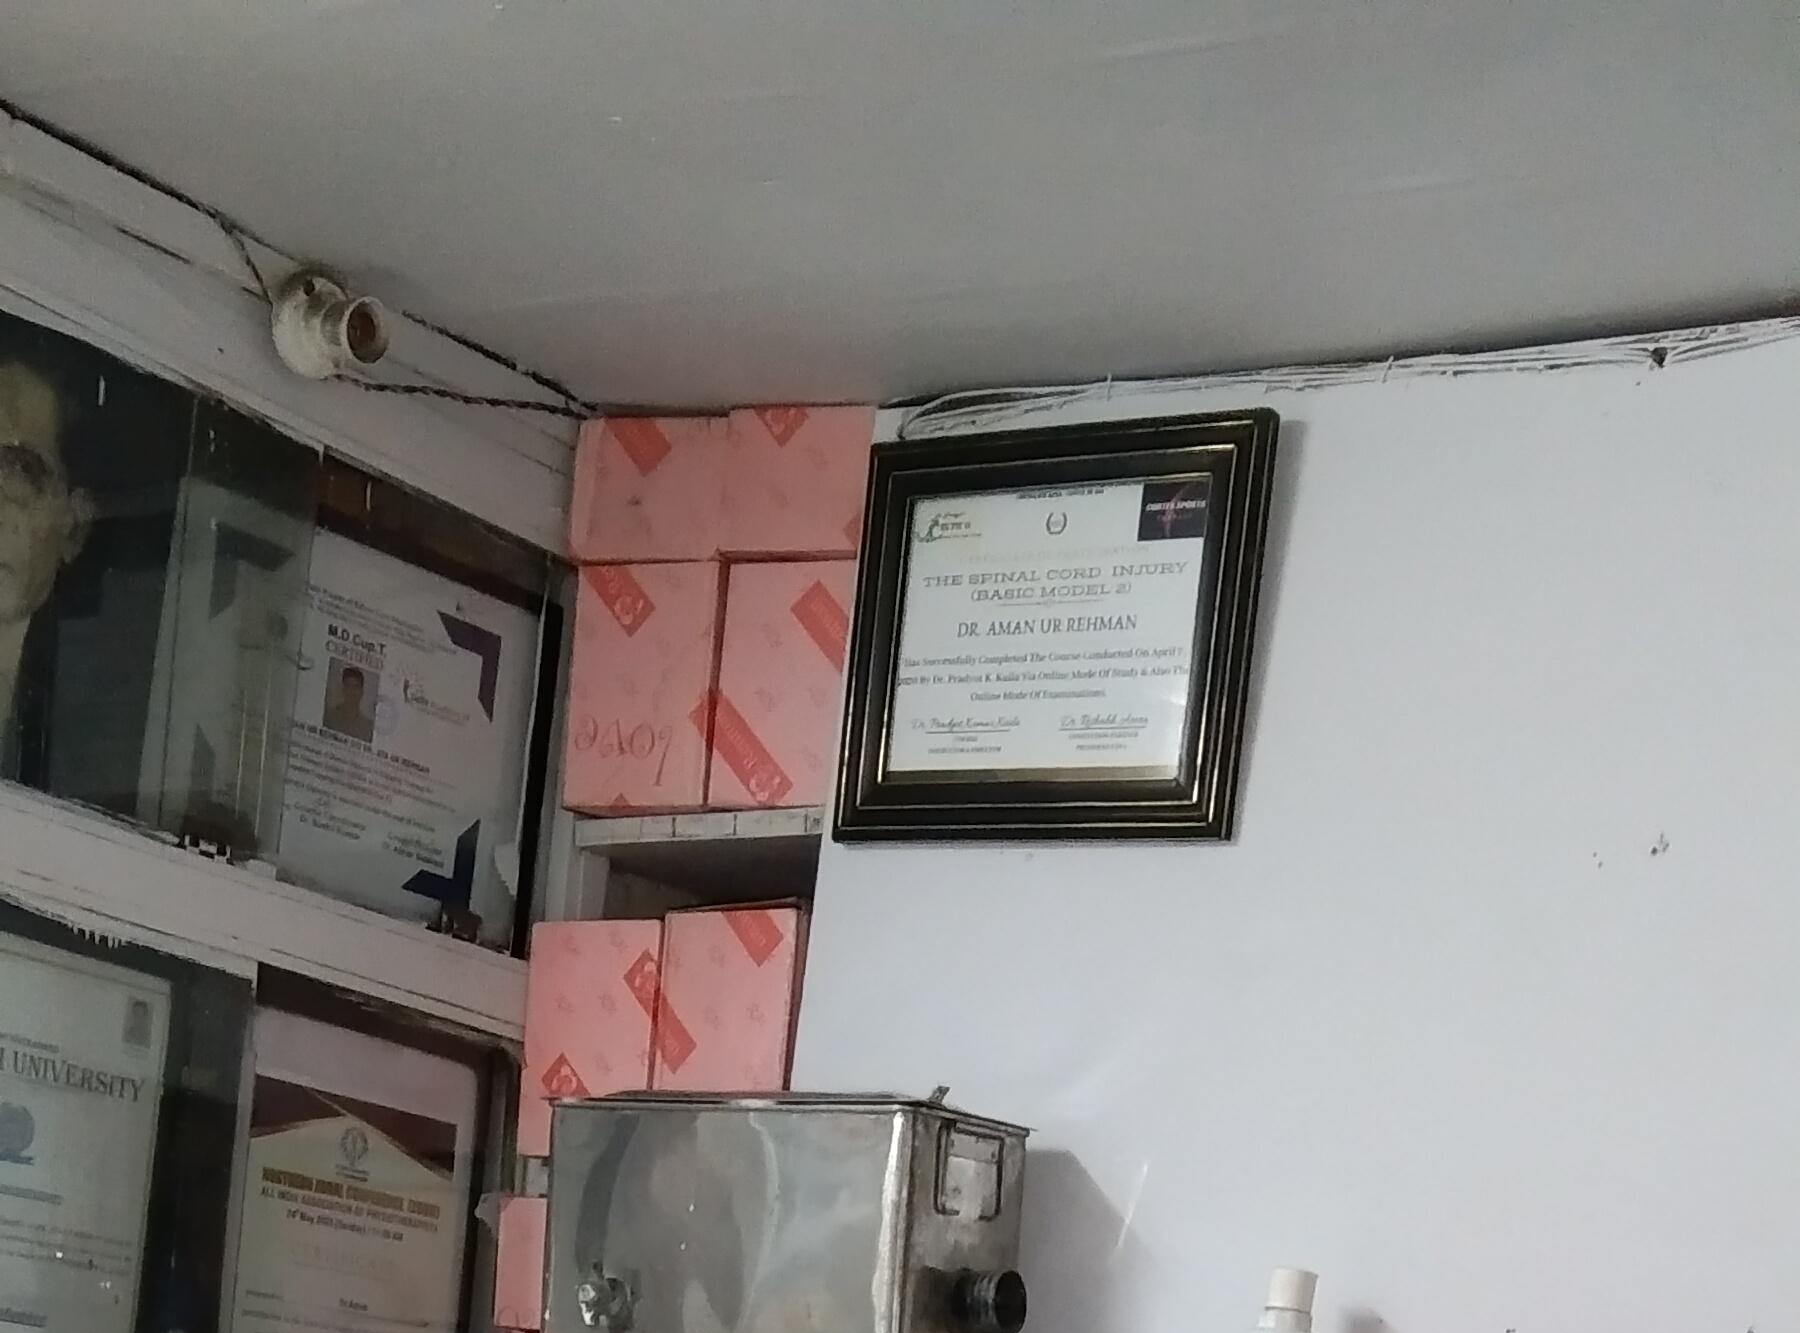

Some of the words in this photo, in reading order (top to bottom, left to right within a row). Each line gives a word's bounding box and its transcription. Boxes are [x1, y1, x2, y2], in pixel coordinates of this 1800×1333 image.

[923, 575, 963, 588] THE
[968, 569, 1041, 585] SPINAL
[1046, 566, 1102, 581] CORD
[1111, 561, 1189, 577] INJURY
[970, 587, 1036, 602] (BASIC
[1041, 583, 1110, 599] MODEL
[986, 619, 1036, 637] AMAN
[1040, 618, 1063, 634] UR
[1066, 614, 1137, 633] REHMAN
[13, 1050, 145, 1102] UNIVERSITY
